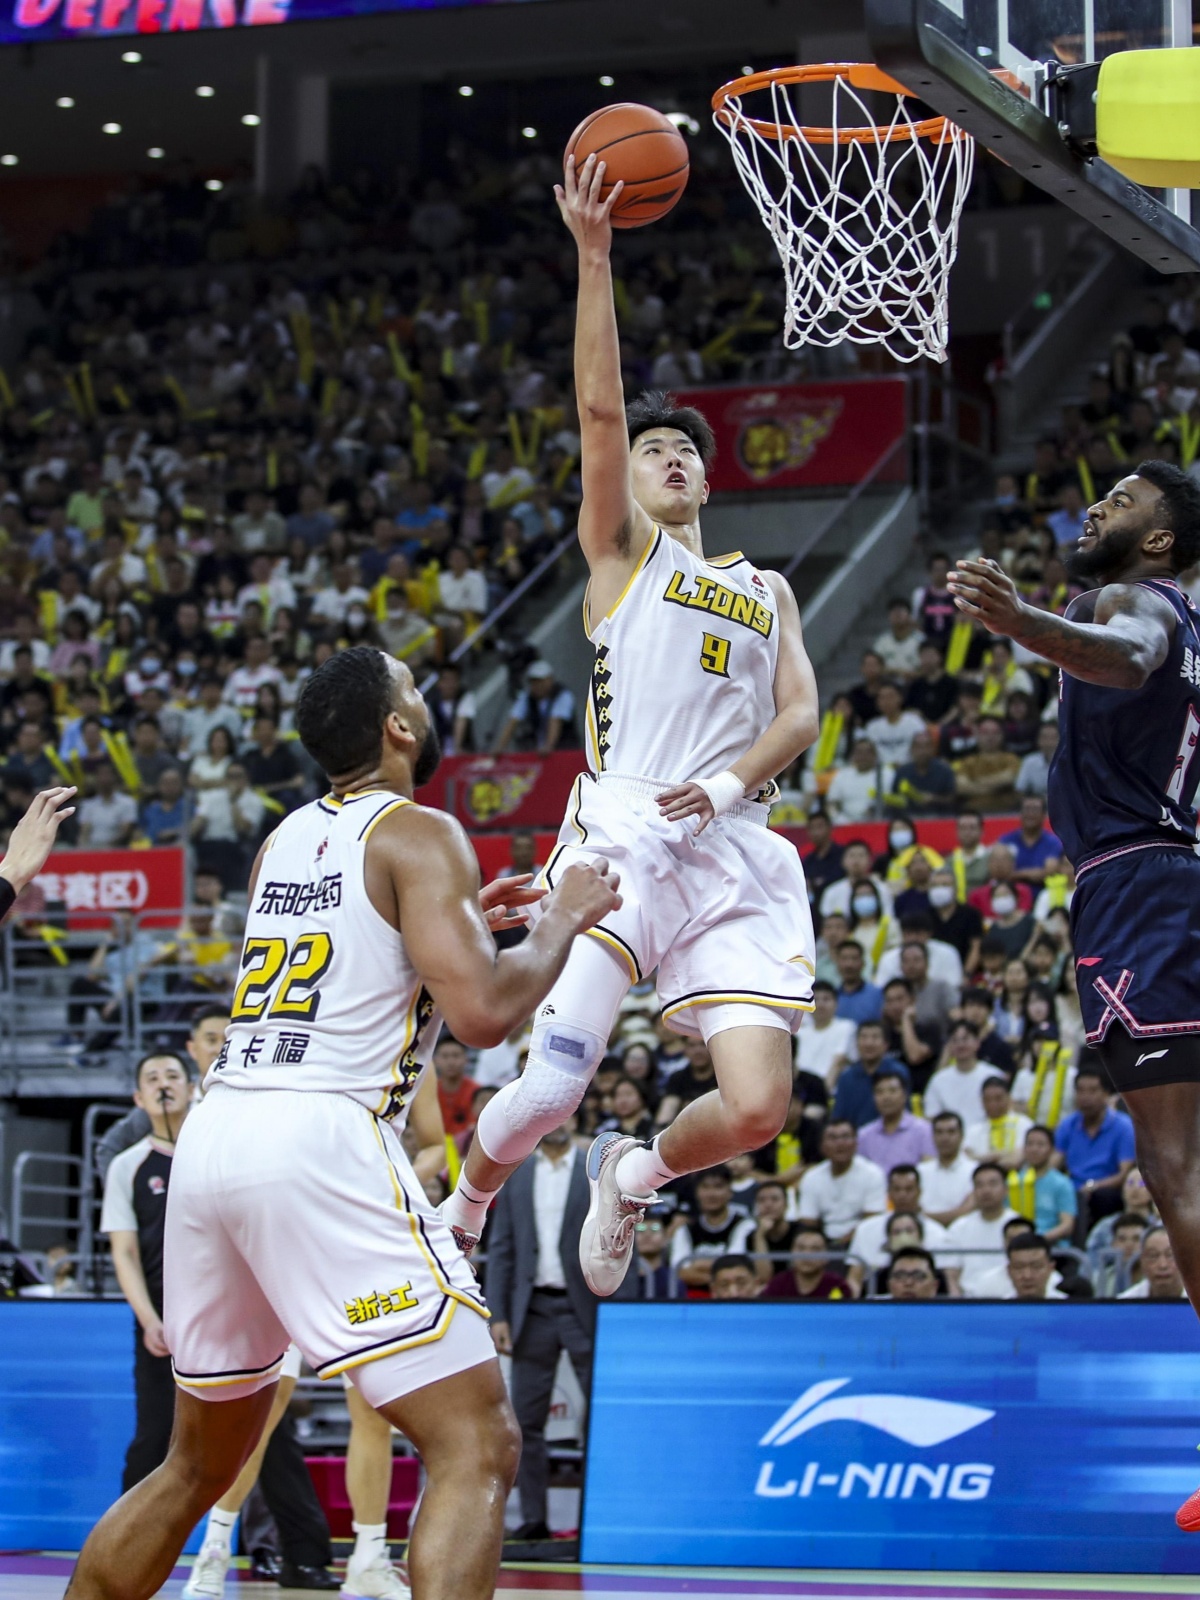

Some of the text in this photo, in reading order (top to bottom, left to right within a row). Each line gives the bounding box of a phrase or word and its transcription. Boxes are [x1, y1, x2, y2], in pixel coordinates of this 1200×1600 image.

[663, 569, 774, 640] LIONS
[699, 631, 731, 679] 9
[230, 932, 334, 1024] 22
[343, 1280, 419, 1325] 浙江
[754, 1461, 995, 1500] LI-NING
